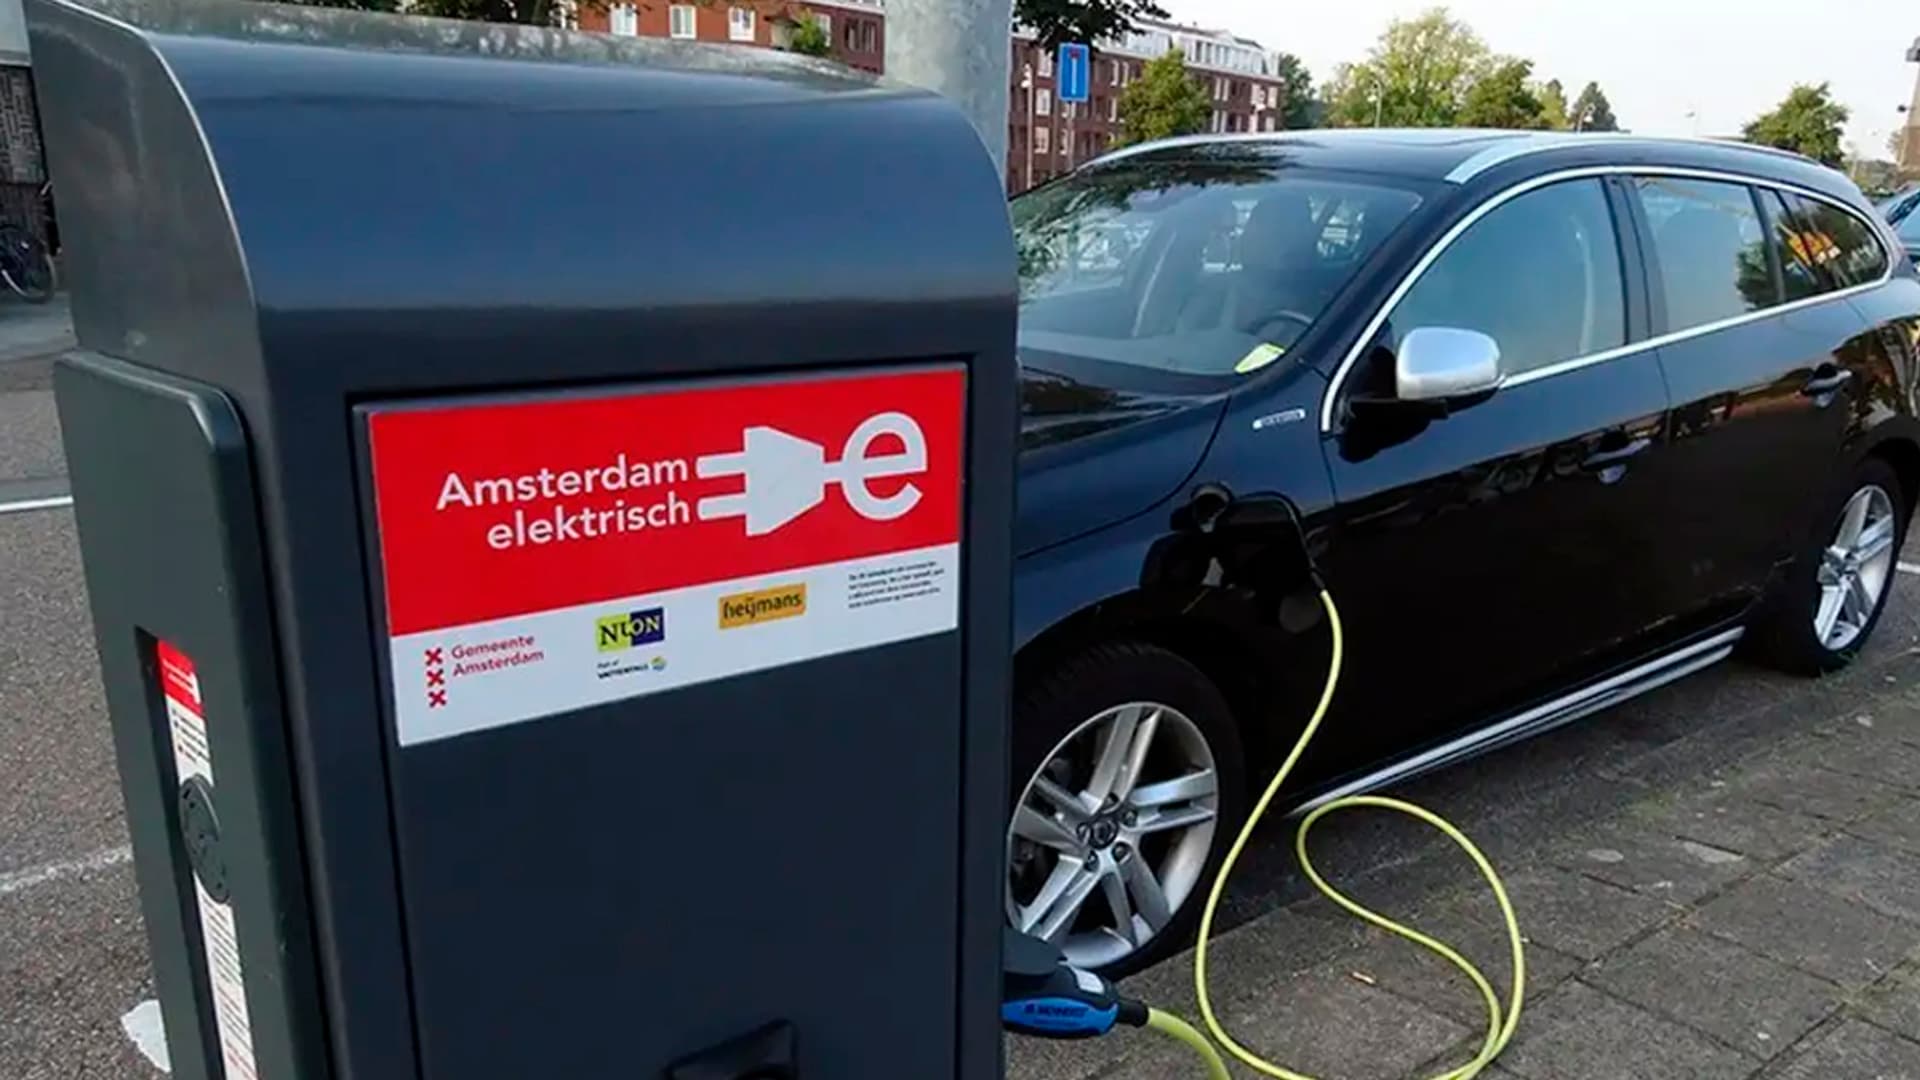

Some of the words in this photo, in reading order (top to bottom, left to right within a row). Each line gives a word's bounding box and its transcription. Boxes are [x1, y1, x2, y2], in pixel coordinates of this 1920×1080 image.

[436, 453, 688, 511] Amsterdam
[487, 490, 690, 549] elektrisch
[599, 615, 660, 646] NUON
[451, 635, 535, 659] Gemeente
[453, 650, 545, 676] Amsterdam
